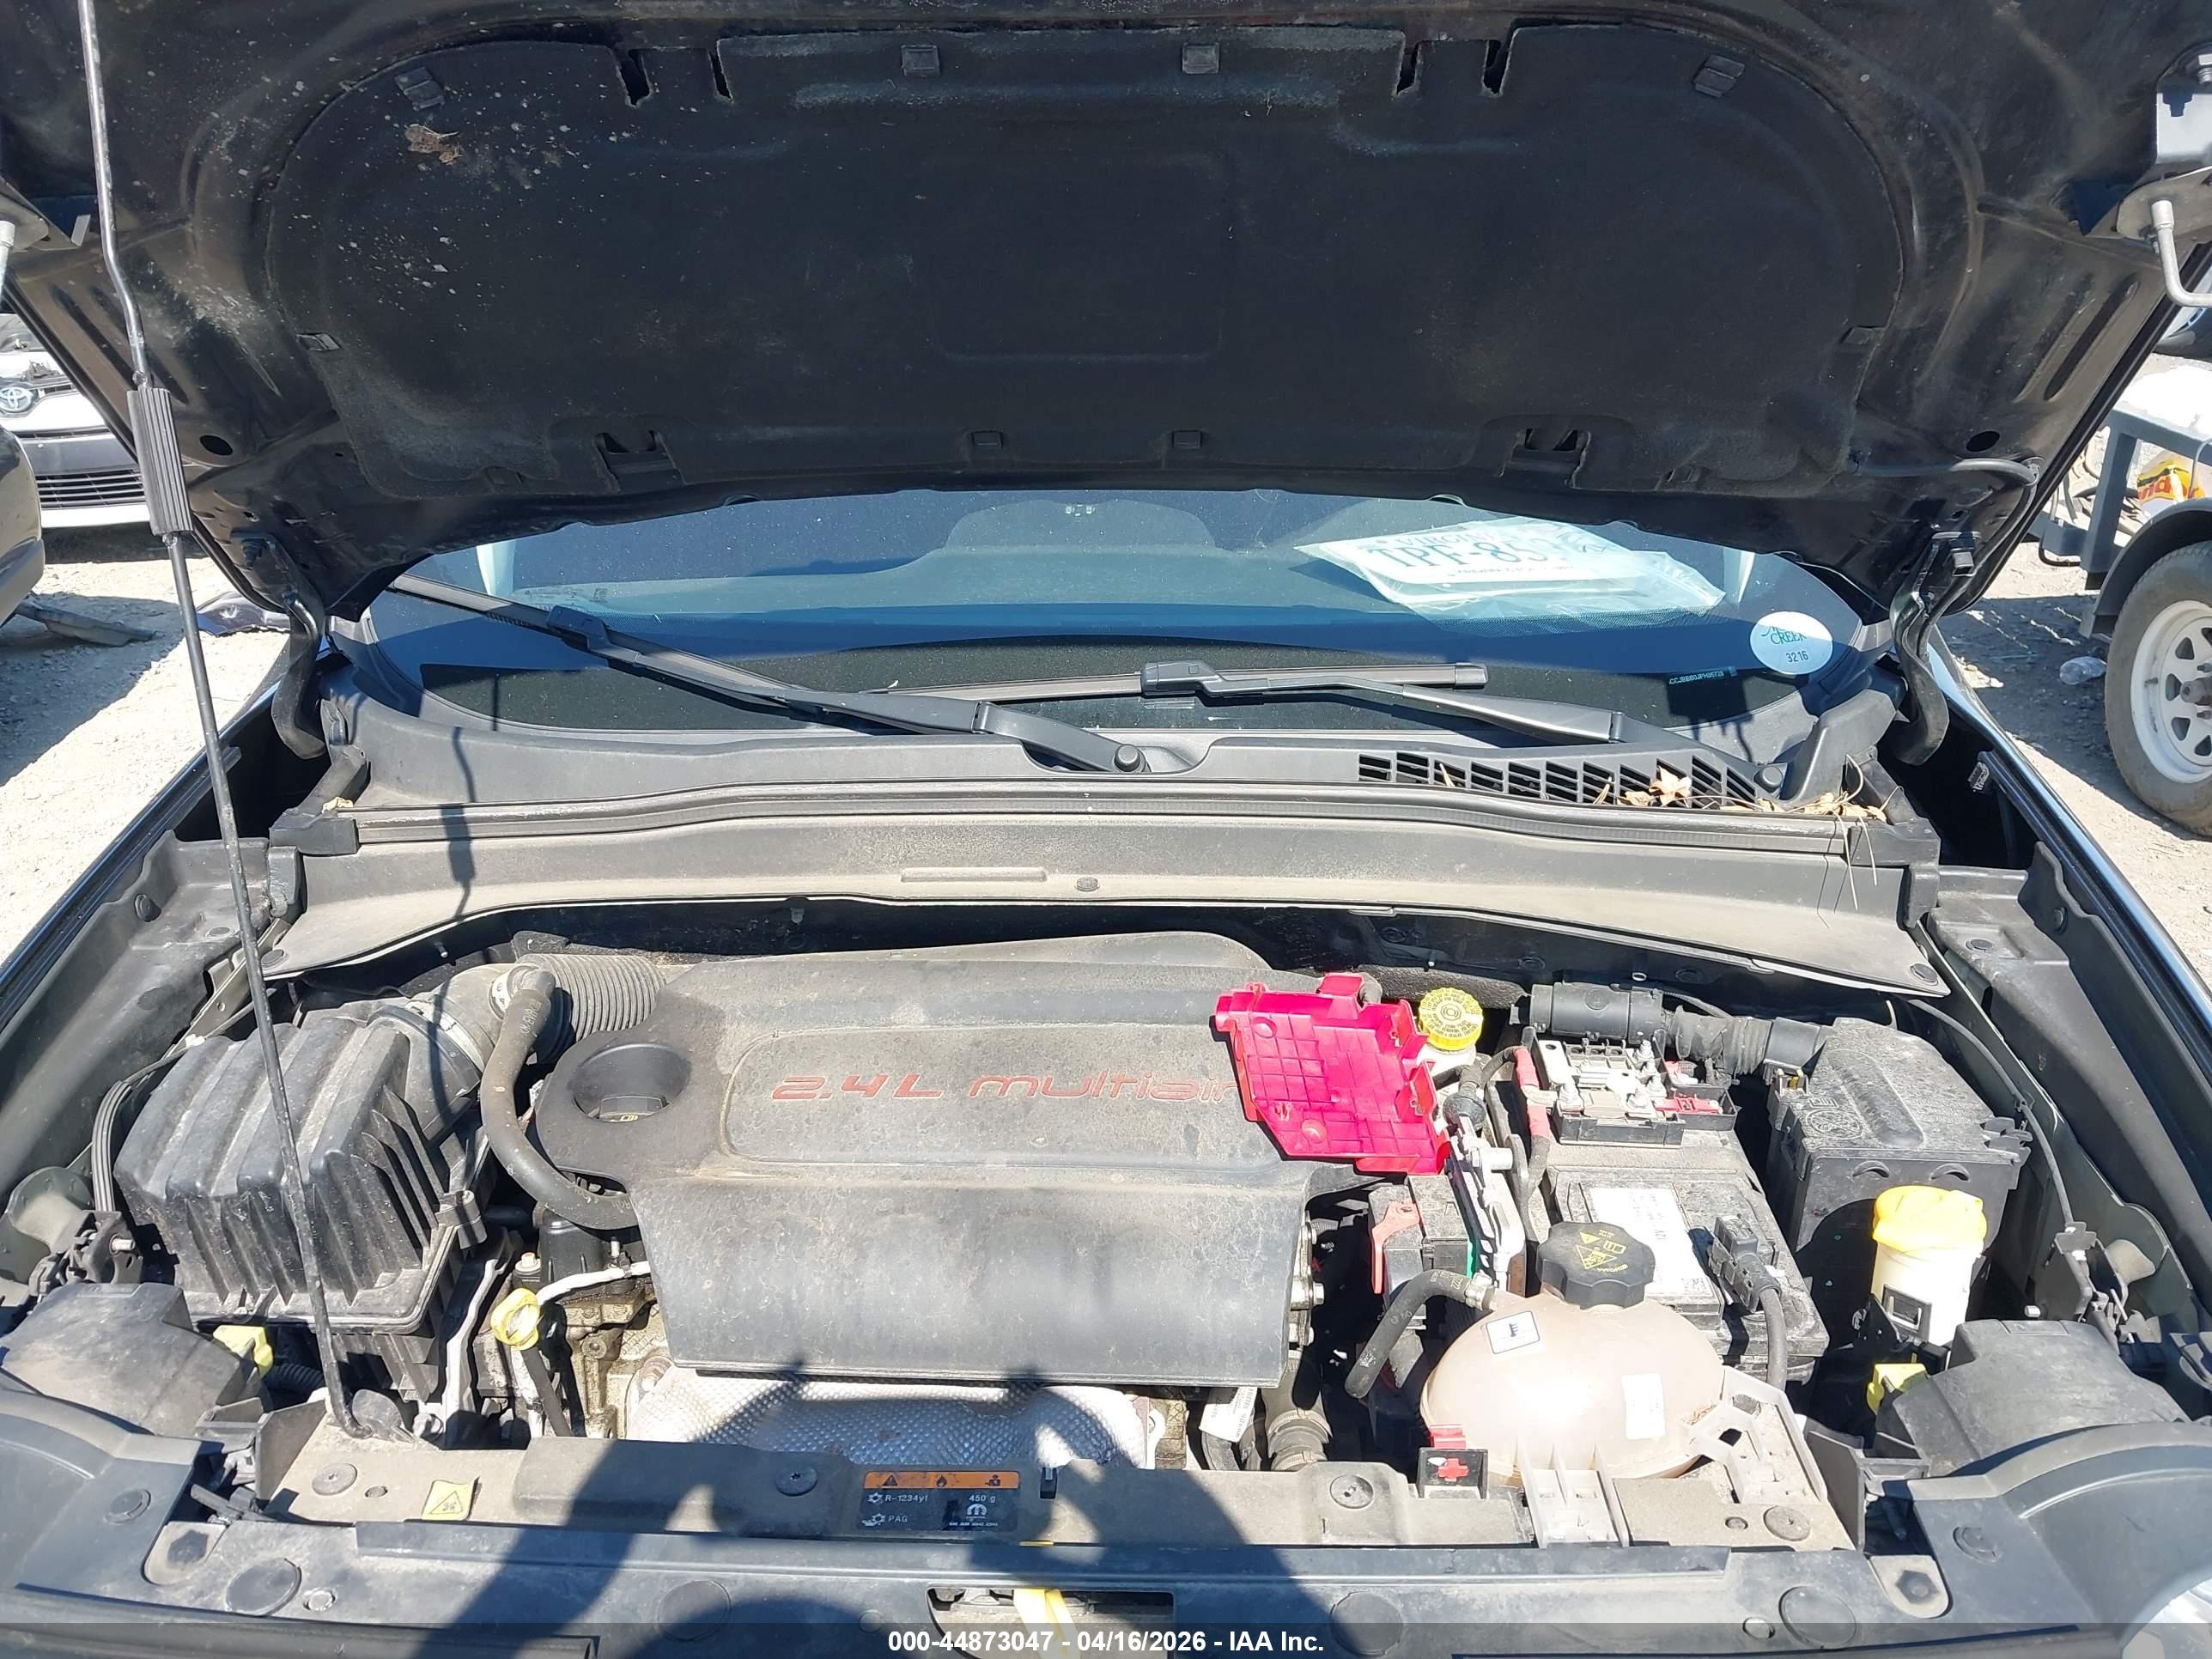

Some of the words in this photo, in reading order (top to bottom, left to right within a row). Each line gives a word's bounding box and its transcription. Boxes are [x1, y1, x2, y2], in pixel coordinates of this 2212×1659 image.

[1785, 650, 1809, 663] 3216
[969, 1071, 1237, 1102] multiair
[968, 1494, 987, 1503] 450
[989, 1495, 997, 1504] g
[888, 1515, 908, 1523] PAG
